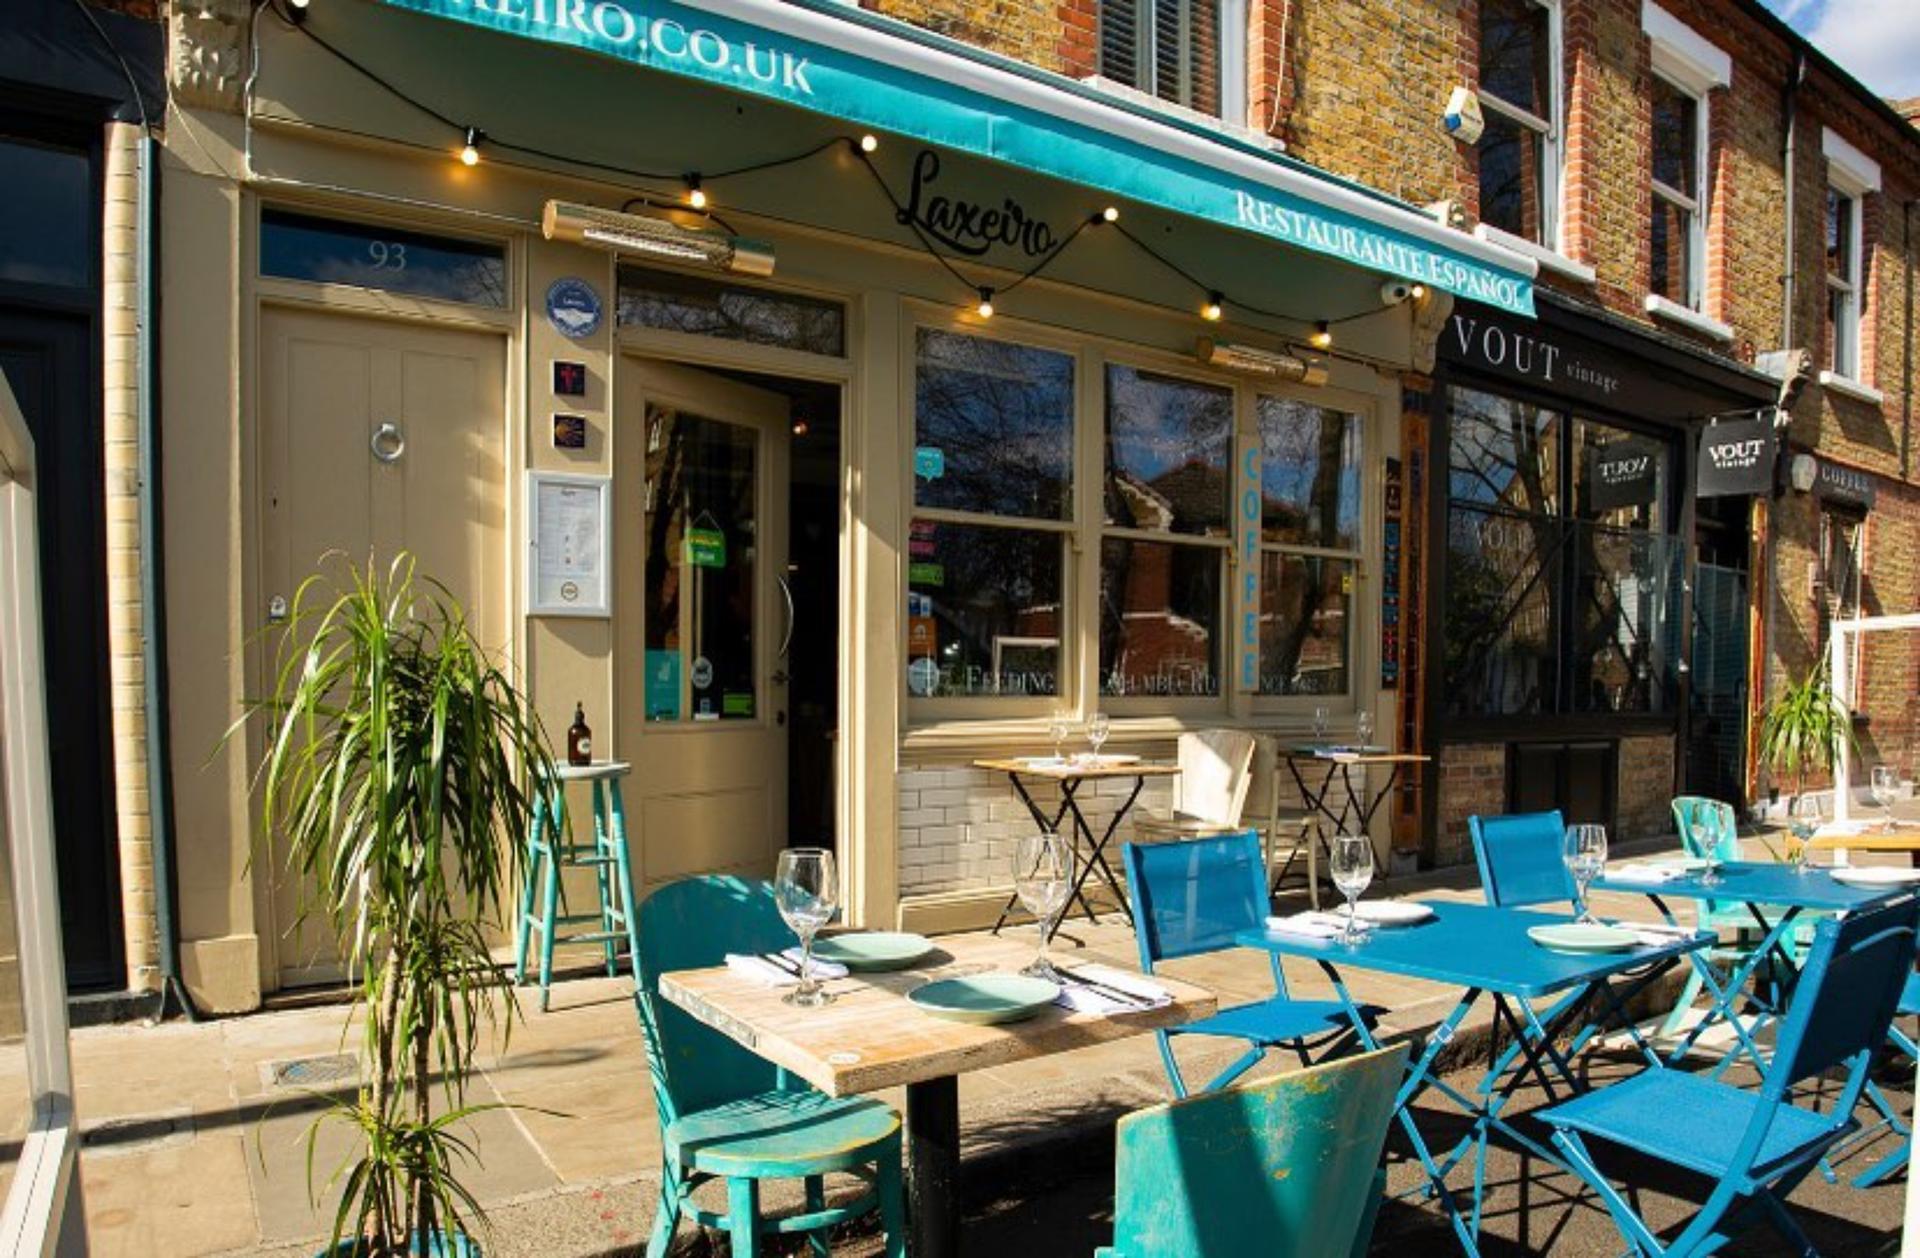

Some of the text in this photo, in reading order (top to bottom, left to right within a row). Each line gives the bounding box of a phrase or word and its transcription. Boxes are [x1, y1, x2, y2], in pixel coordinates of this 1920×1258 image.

[897, 150, 1058, 257] Laxeiro
[1236, 191, 1525, 309] RESTAURANTE ESPAÑOL
[368, 240, 407, 272] 93
[1453, 314, 1618, 394] VOUT vintage
[1708, 439, 1766, 462] VOUT
[1242, 447, 1260, 687] COFFEE
